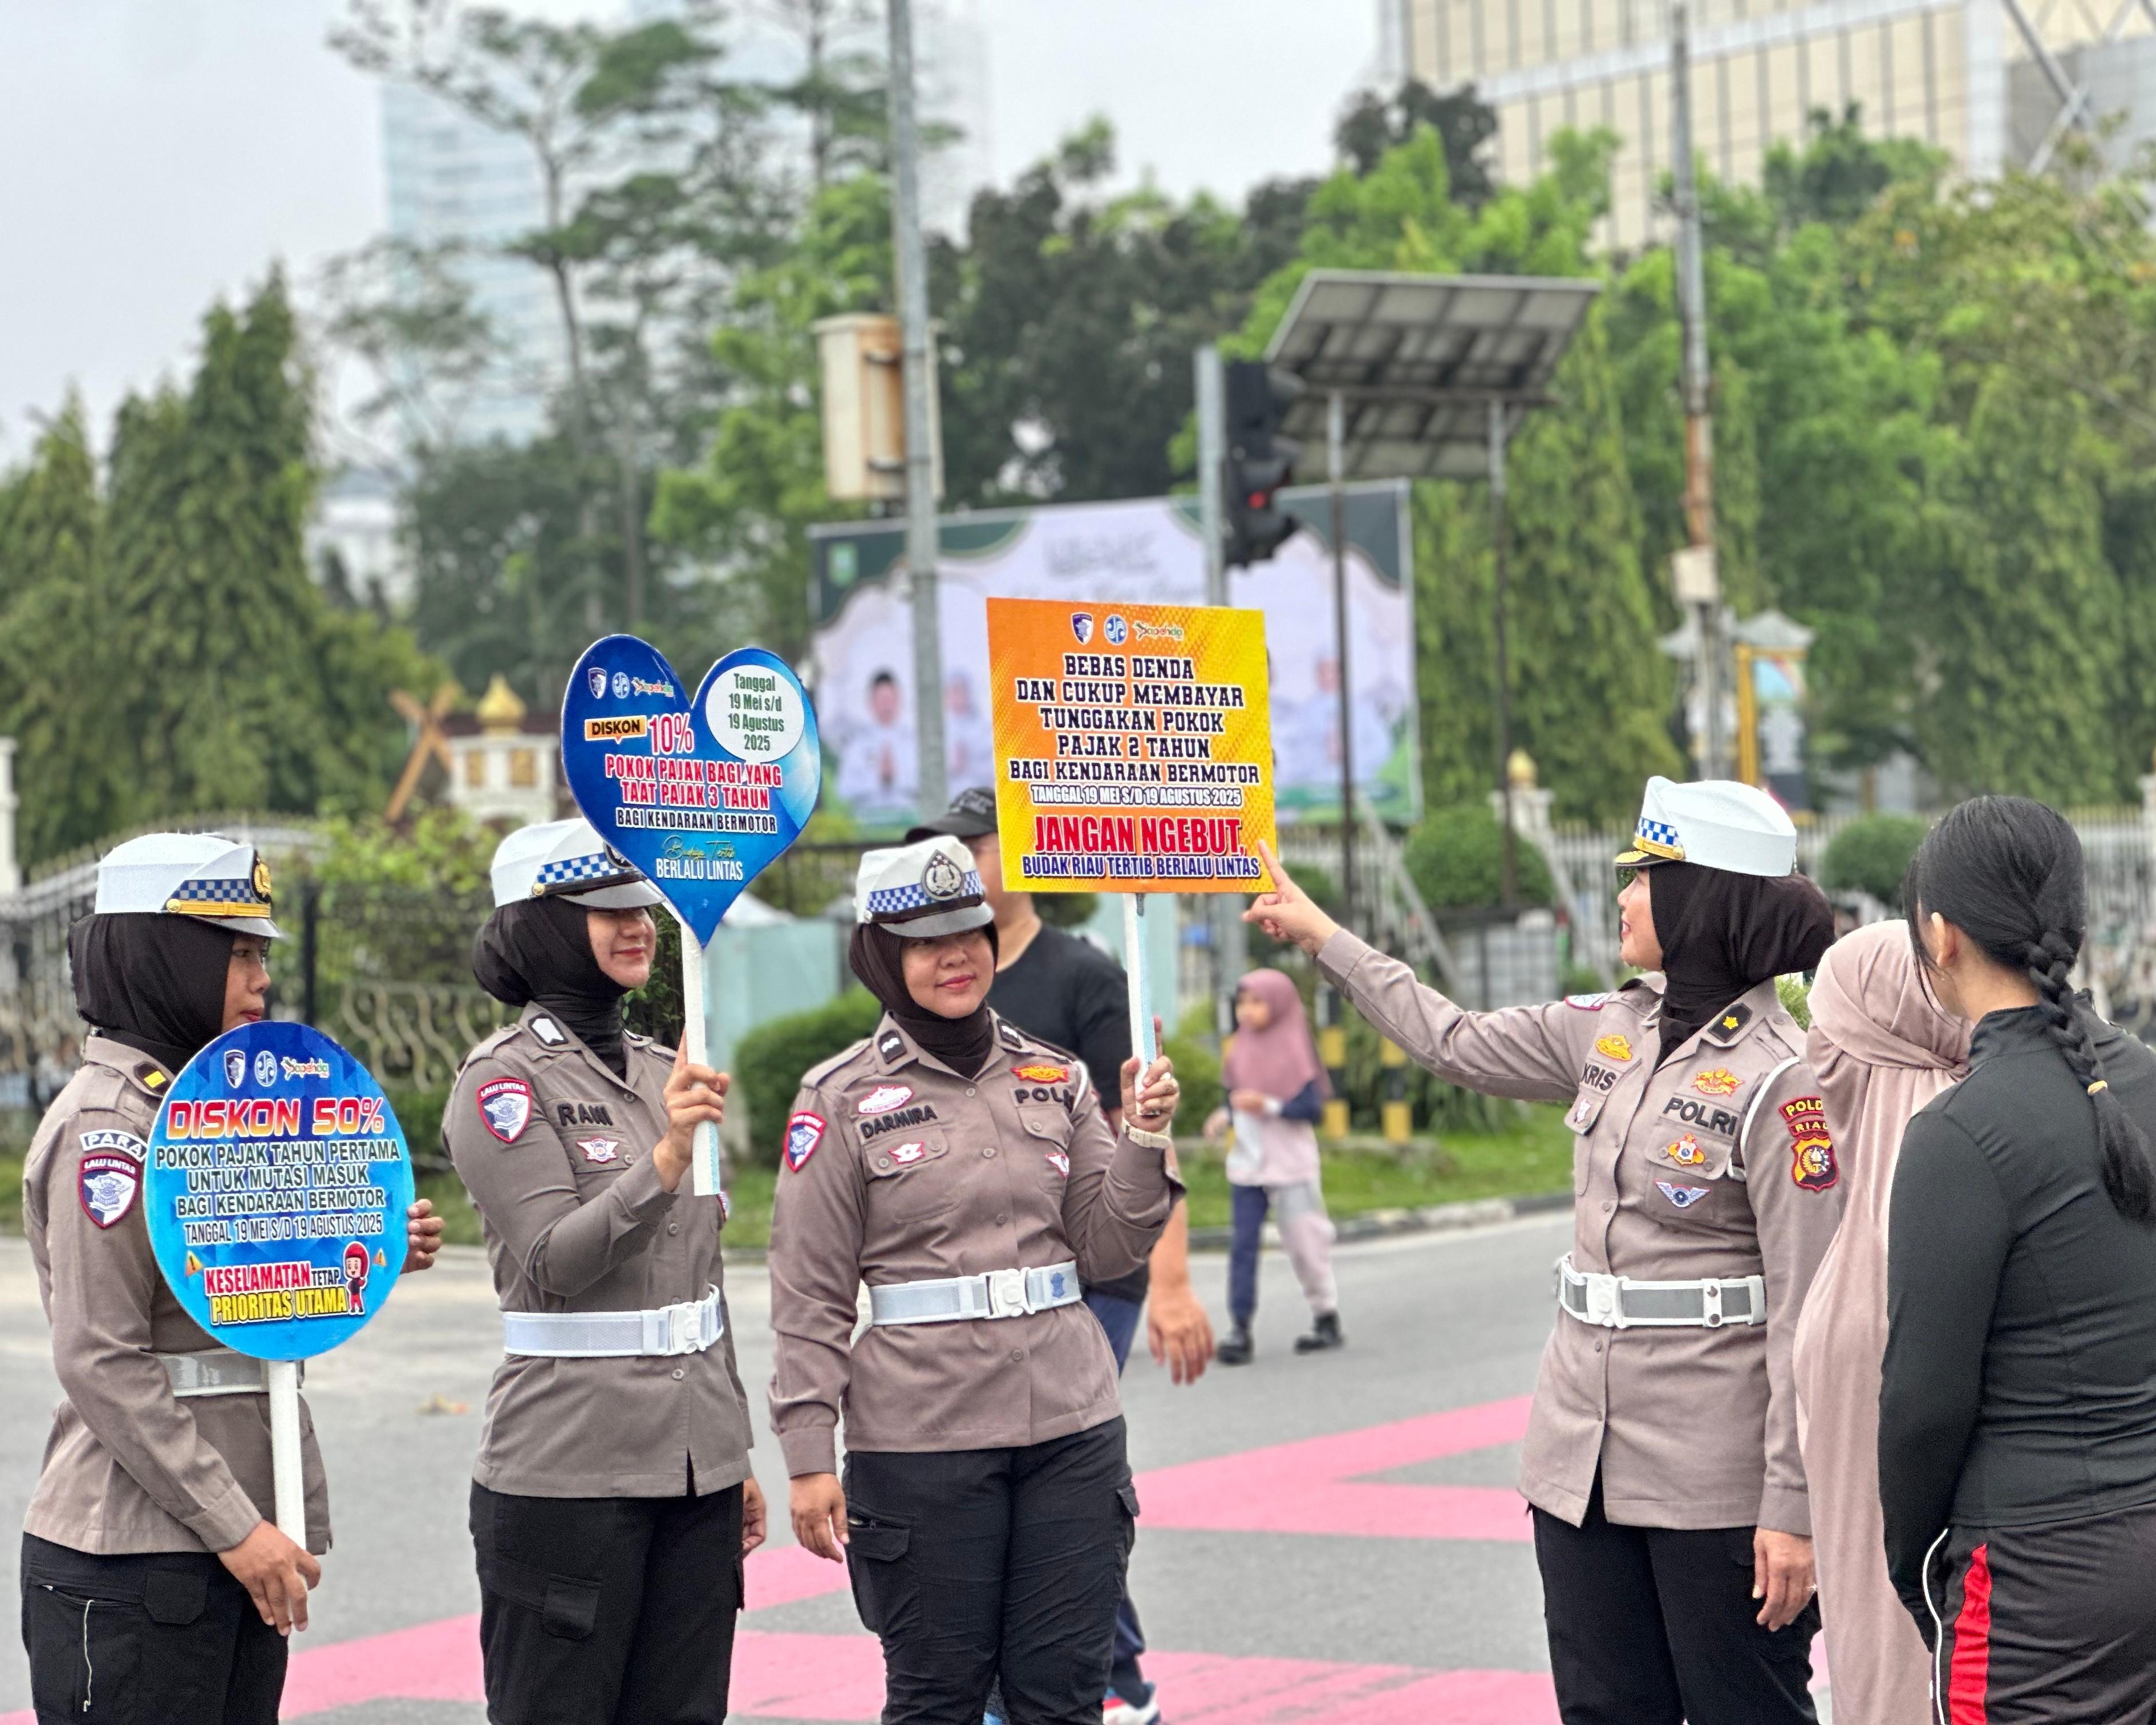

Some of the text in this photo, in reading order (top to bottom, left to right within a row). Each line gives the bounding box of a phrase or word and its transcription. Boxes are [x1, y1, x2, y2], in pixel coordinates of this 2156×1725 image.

[1064, 655, 1194, 679] BEBAS DENDA
[733, 673, 776, 692] Tanggal
[1017, 679, 1243, 707] DAN CUKUP MEMBAYAR
[729, 694, 782, 712] 19 Mei s/d
[728, 714, 784, 732] 19 Agustus
[1040, 707, 1223, 732] TUNGGAKAN POKOK
[591, 714, 694, 754] DISKON 10%
[744, 735, 771, 751] 2025
[1058, 735, 1210, 758] PAJAK 2 TAHUN
[605, 755, 782, 787] POKOK PAJAK BAGI YANG
[1010, 760, 1259, 784] BAGI KENDARAAN BERMOTOR
[621, 781, 769, 809] TAAT PAJAK 3 TAHUN
[1032, 785, 1242, 806] TANGGAL 19 MEI S/D 19 AGUSTUS 2025
[617, 808, 776, 833] BAGI KENDARAAN BERMOTOR
[1035, 816, 1245, 857] JANGAN NGEBUT,
[656, 858, 743, 880] BERLALU LINTAS
[1023, 856, 1260, 877] BUDAK RIAU TERTIB BERLALU LINTAS
[1581, 1063, 1616, 1091] KRIS
[167, 1098, 384, 1139] DISKON 50%
[1663, 1097, 1738, 1135] POLRI
[1785, 1099, 1823, 1116] POLD
[861, 1106, 938, 1139] DARMIRA
[87, 1133, 143, 1157] PARA
[156, 1140, 400, 1168] POKOK PAJAK TAHUN PERTAMA
[188, 1165, 368, 1191] UNTUK MUTASI MASUK
[177, 1188, 385, 1217] BAGI KENDARAAN BERMOTOR
[185, 1214, 383, 1245] TANGGAL 19 MEI S/D 19 AGUSTUS 2025
[205, 1263, 339, 1294] KESELAMATAN TETAP
[212, 1286, 347, 1323] PRIORITAS UTAMA
